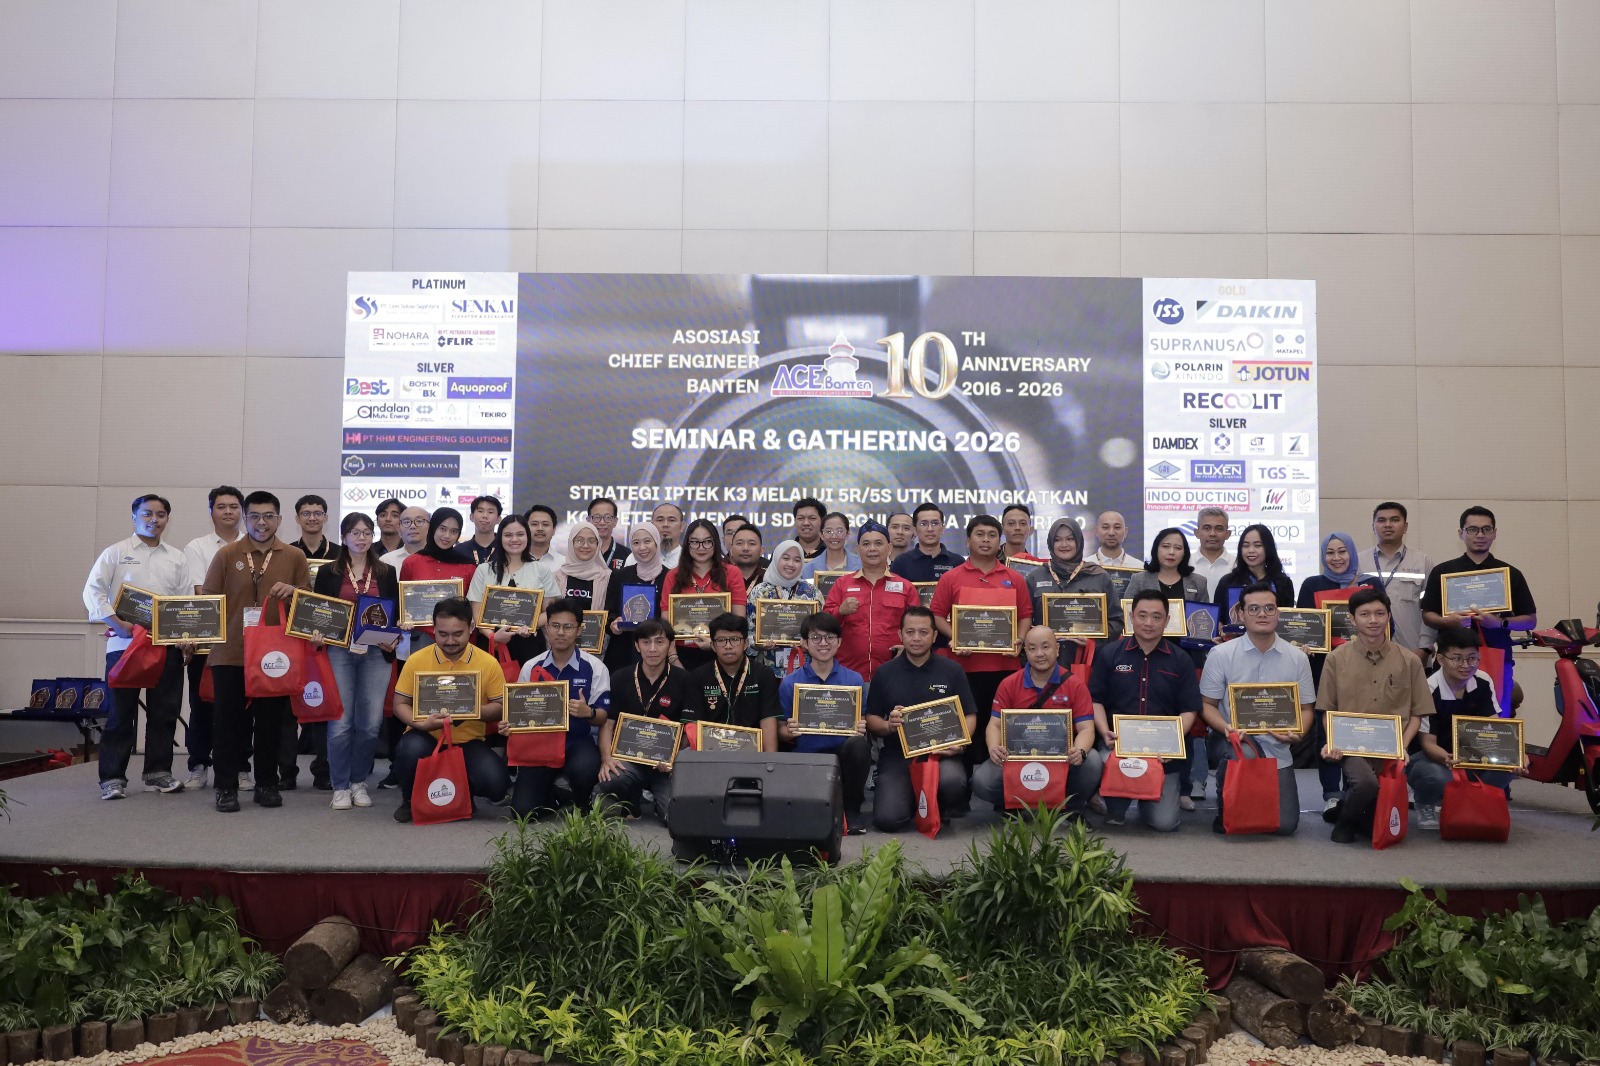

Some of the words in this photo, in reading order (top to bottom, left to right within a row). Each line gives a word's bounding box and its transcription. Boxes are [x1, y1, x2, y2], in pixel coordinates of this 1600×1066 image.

[412, 279, 466, 290] PLATINUM
[1218, 286, 1246, 296] GOLD
[452, 300, 514, 313] SENKAI
[1216, 306, 1298, 318] DAIKIN
[386, 332, 430, 340] NOHARA
[672, 330, 760, 344] ASOSIASI
[962, 332, 986, 346] TH
[1150, 338, 1246, 352] SUPRANUSA
[417, 362, 454, 373] SILVER
[608, 354, 664, 368] CHIEF
[668, 354, 760, 368] ENGINEER
[876, 332, 958, 400] 10
[962, 357, 1092, 372] ANNIVERSARY
[1175, 363, 1223, 371] POLARIN
[772, 364, 824, 389] ACE
[1254, 367, 1309, 381] JOTUN
[346, 378, 390, 396] Best
[450, 382, 507, 394] Aquaproof
[686, 378, 760, 394] BANTEN
[962, 382, 1002, 396] 2016
[1018, 382, 1063, 396] 2026
[357, 403, 410, 419] andalan
[1209, 418, 1247, 428] SILVER
[631, 428, 756, 449] SEMINAR
[762, 430, 780, 450] &
[788, 429, 947, 451] GATHERING
[954, 432, 1021, 452] 2026
[1153, 438, 1199, 450] DAMDEX
[1195, 464, 1242, 475] LUXEN
[1259, 467, 1287, 479] TGS
[369, 489, 427, 499] VENINDO
[570, 485, 659, 500] STRATEGI
[665, 486, 720, 501] IPTEK
[724, 487, 747, 501] K3
[839, 487, 892, 504] 5R/5S
[896, 488, 933, 504] UTK
[938, 489, 1088, 505] MENINGKATKAN
[1148, 492, 1181, 502] INDO
[1186, 492, 1247, 502] DUCTING
